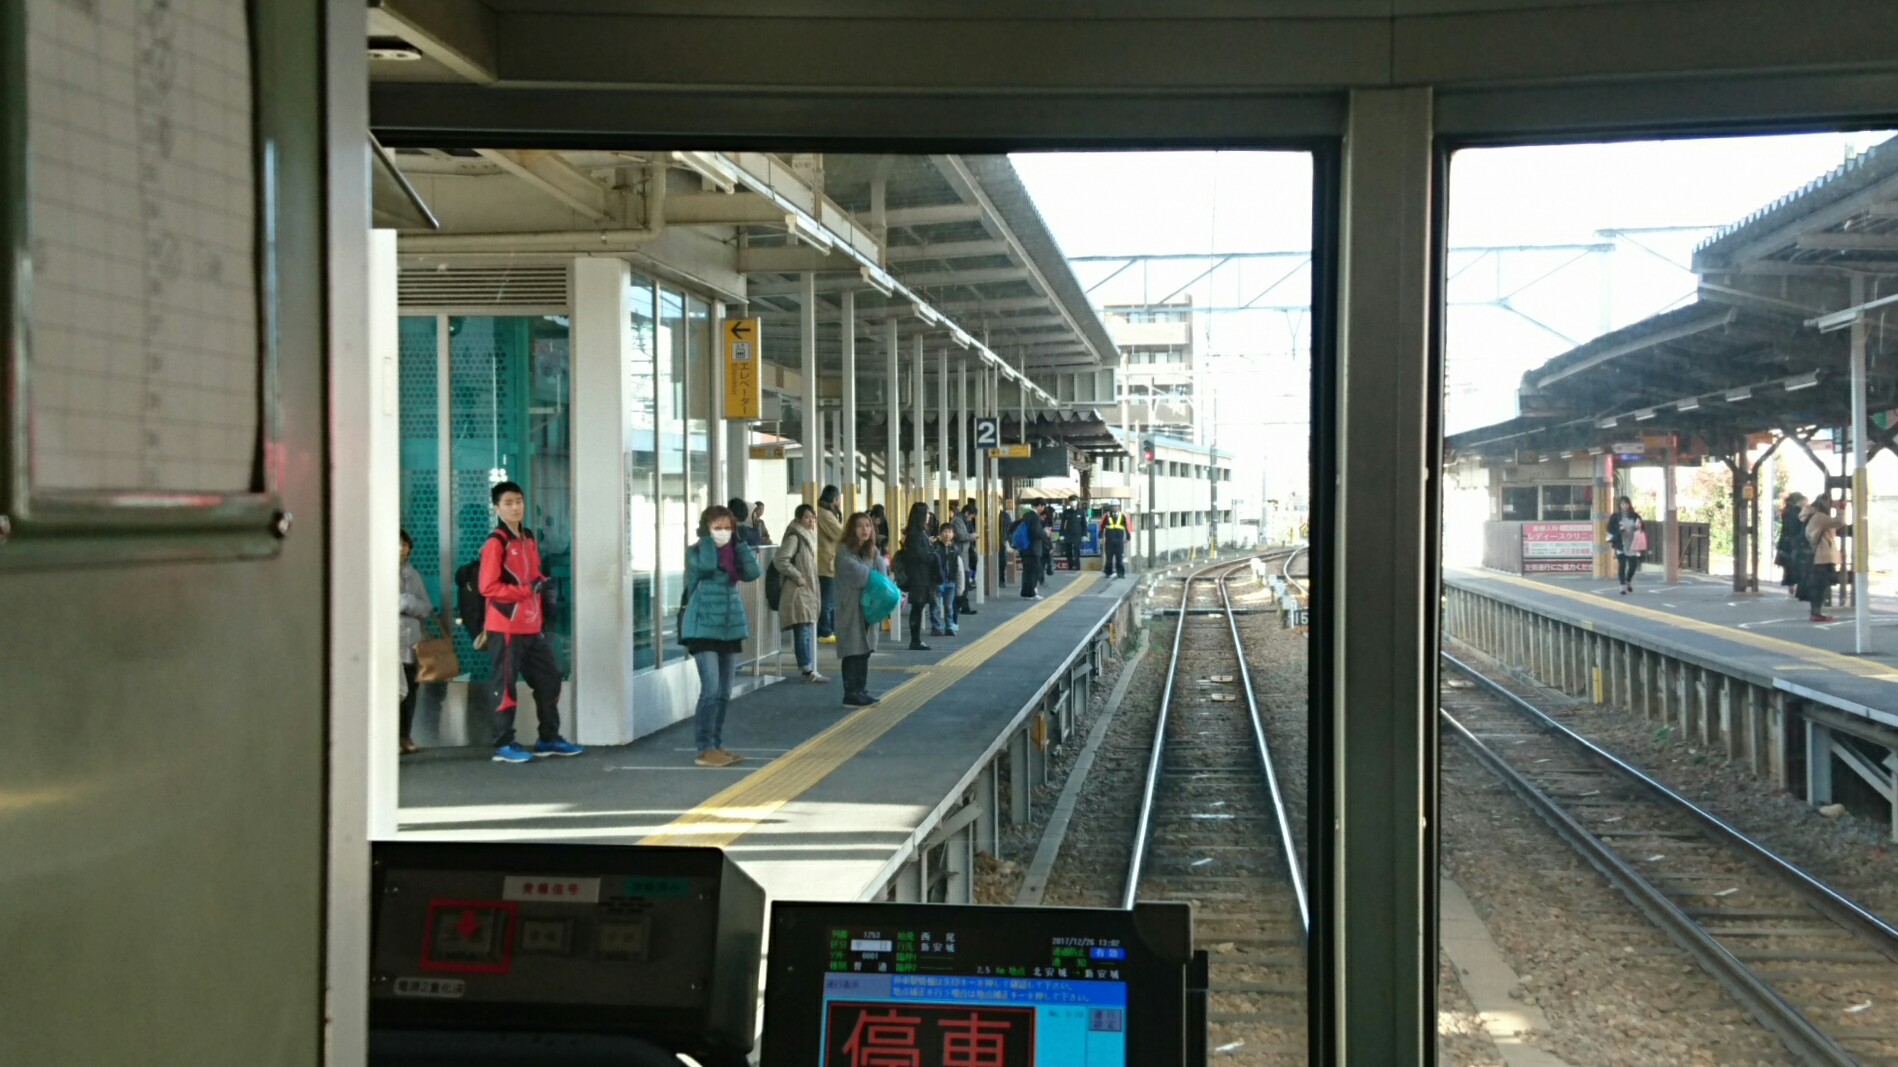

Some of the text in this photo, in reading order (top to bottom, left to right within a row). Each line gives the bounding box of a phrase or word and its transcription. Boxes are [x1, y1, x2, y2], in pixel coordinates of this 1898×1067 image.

[740, 362, 750, 415] エレベーター
[978, 421, 995, 443] 2
[842, 1009, 1011, 1067] 停車
